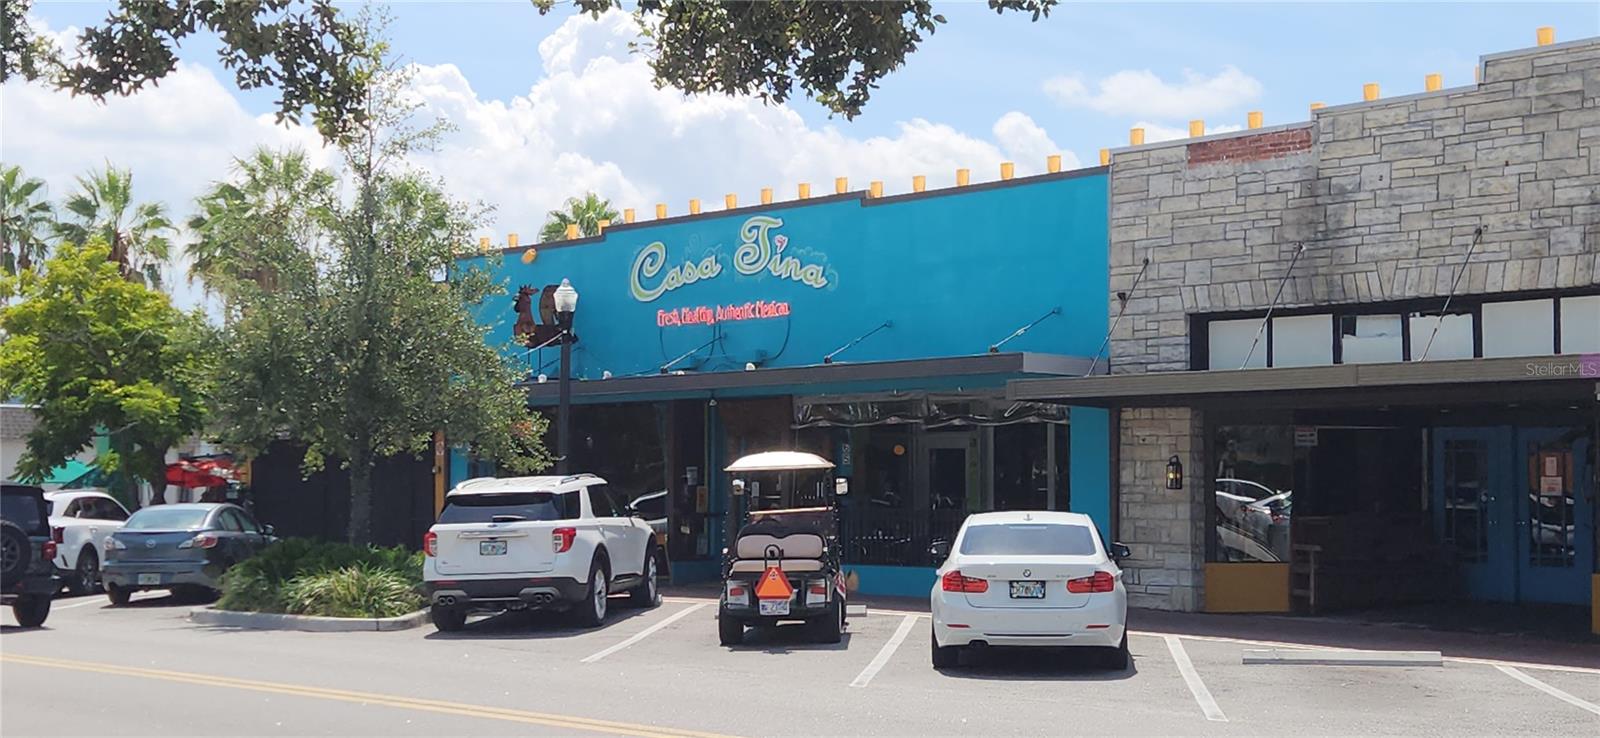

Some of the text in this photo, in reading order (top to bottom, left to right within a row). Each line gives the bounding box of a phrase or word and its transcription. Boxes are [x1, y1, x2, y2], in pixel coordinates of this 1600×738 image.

[631, 215, 828, 302] Casa Tina
[716, 302, 755, 321] Authentic
[755, 300, 790, 318] Mexican
